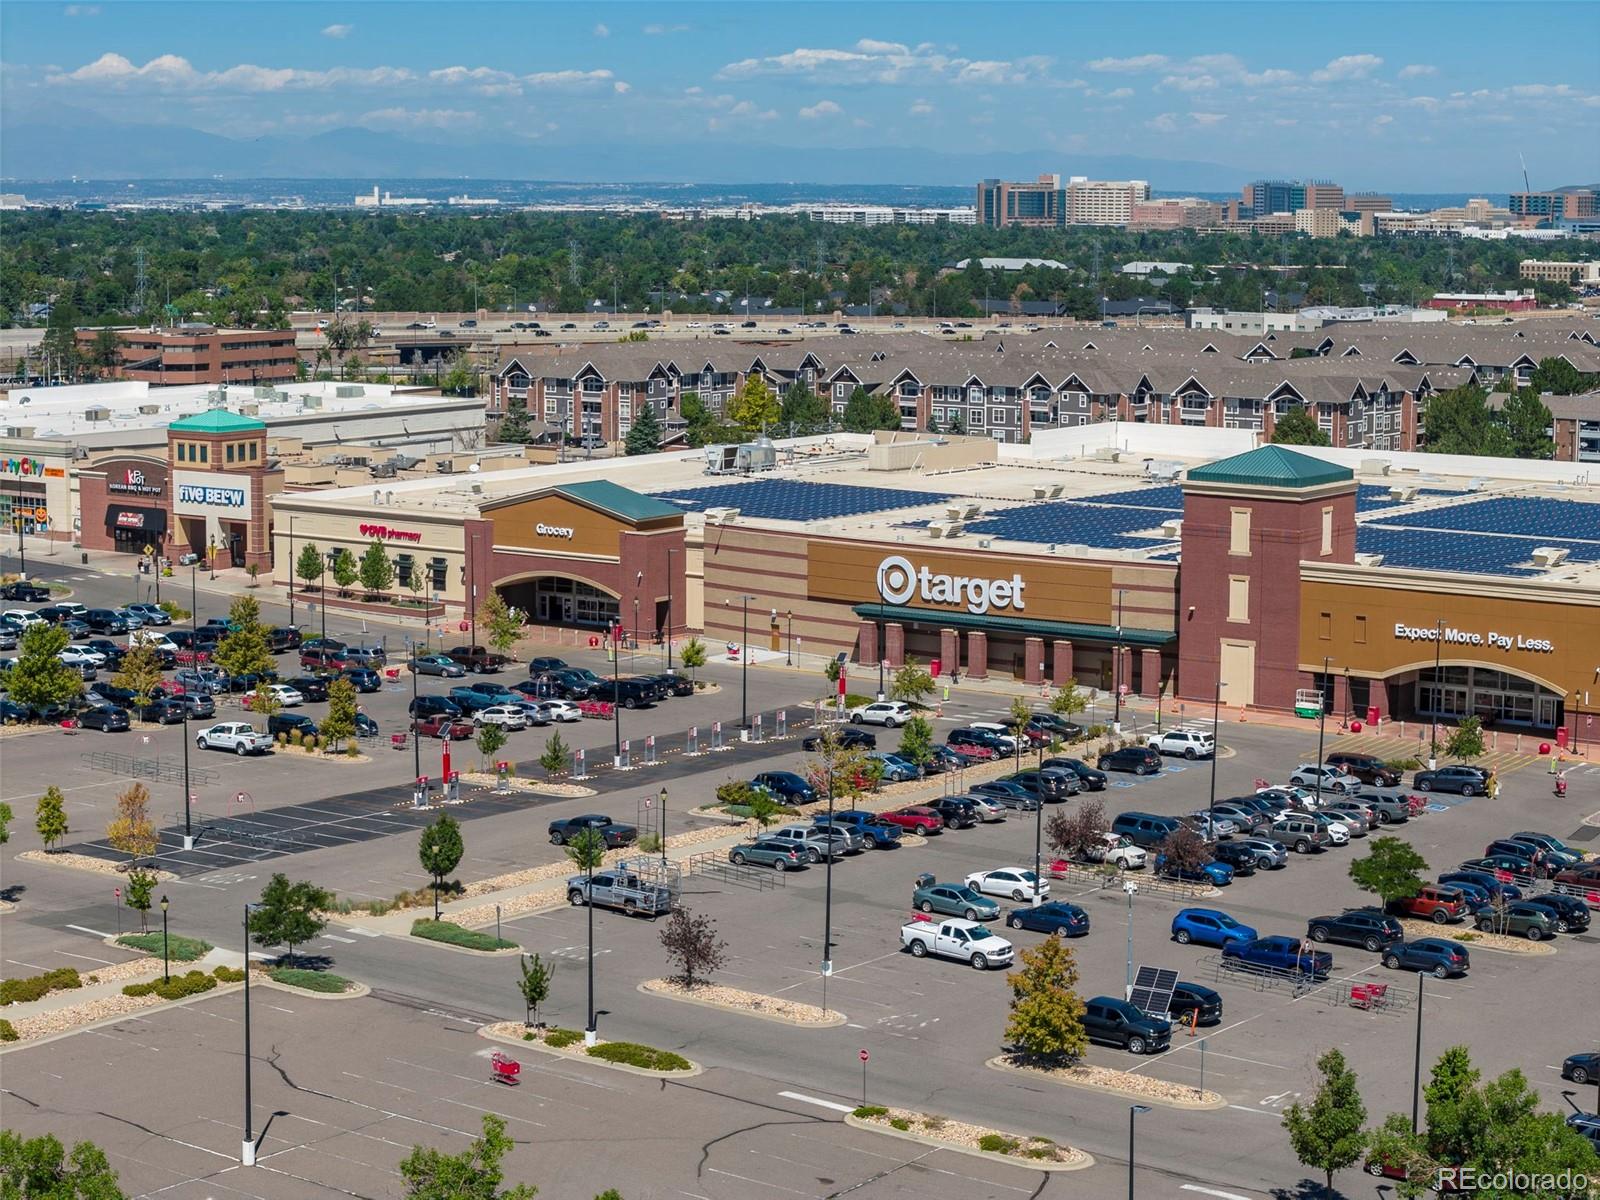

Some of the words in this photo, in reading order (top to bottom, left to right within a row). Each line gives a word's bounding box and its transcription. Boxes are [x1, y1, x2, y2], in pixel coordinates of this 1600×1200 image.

[21, 457, 45, 477] City
[205, 488, 242, 505] BELOW
[369, 525, 387, 538] CVS
[387, 529, 421, 543] pharmacy
[536, 523, 574, 538] Grocery
[918, 566, 1025, 614] target
[1395, 623, 1441, 641] Expect
[1445, 628, 1484, 644] More.
[1488, 632, 1513, 649] Pay
[1517, 635, 1554, 651] Less.
